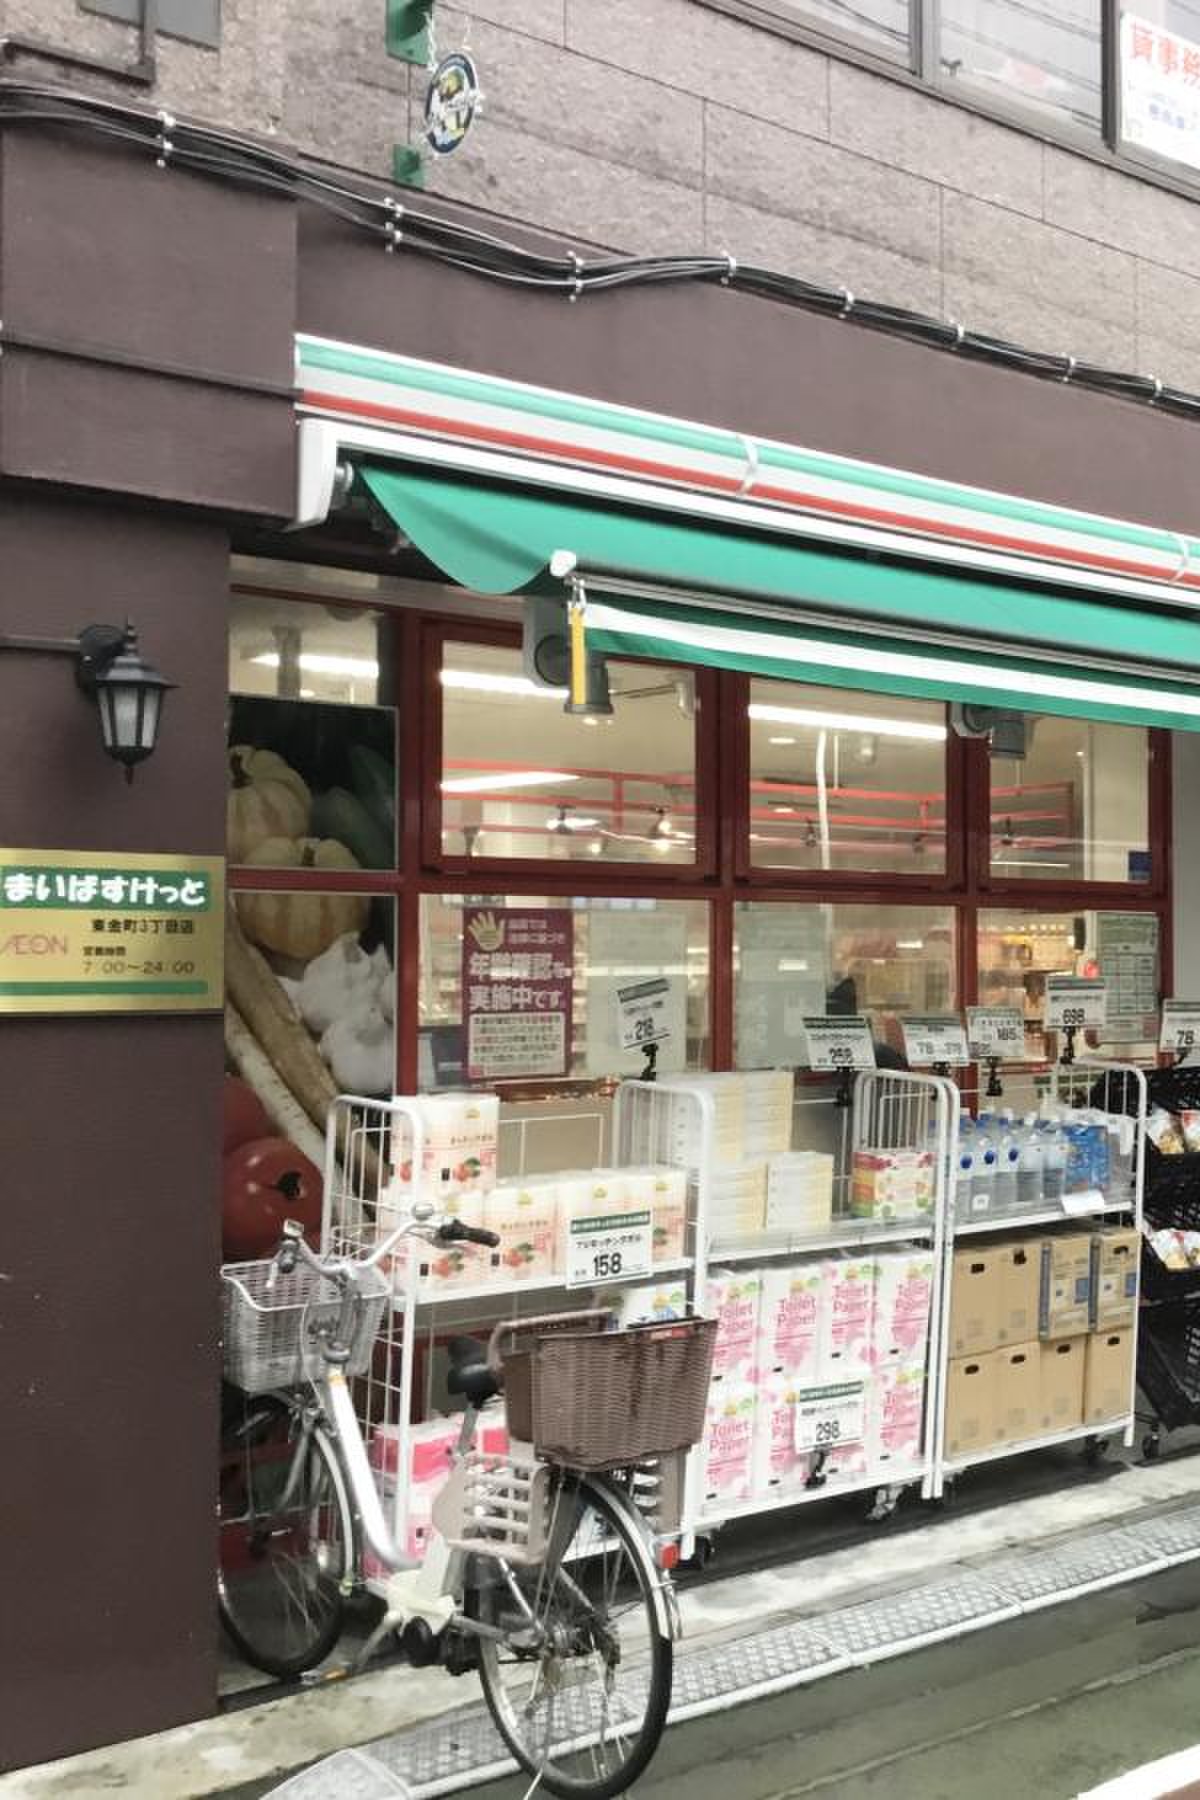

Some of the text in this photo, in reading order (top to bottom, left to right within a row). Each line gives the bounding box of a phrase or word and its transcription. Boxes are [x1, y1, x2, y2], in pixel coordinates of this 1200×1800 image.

[3, 872, 206, 906] まいばすけっと
[594, 1252, 622, 1277] 158
